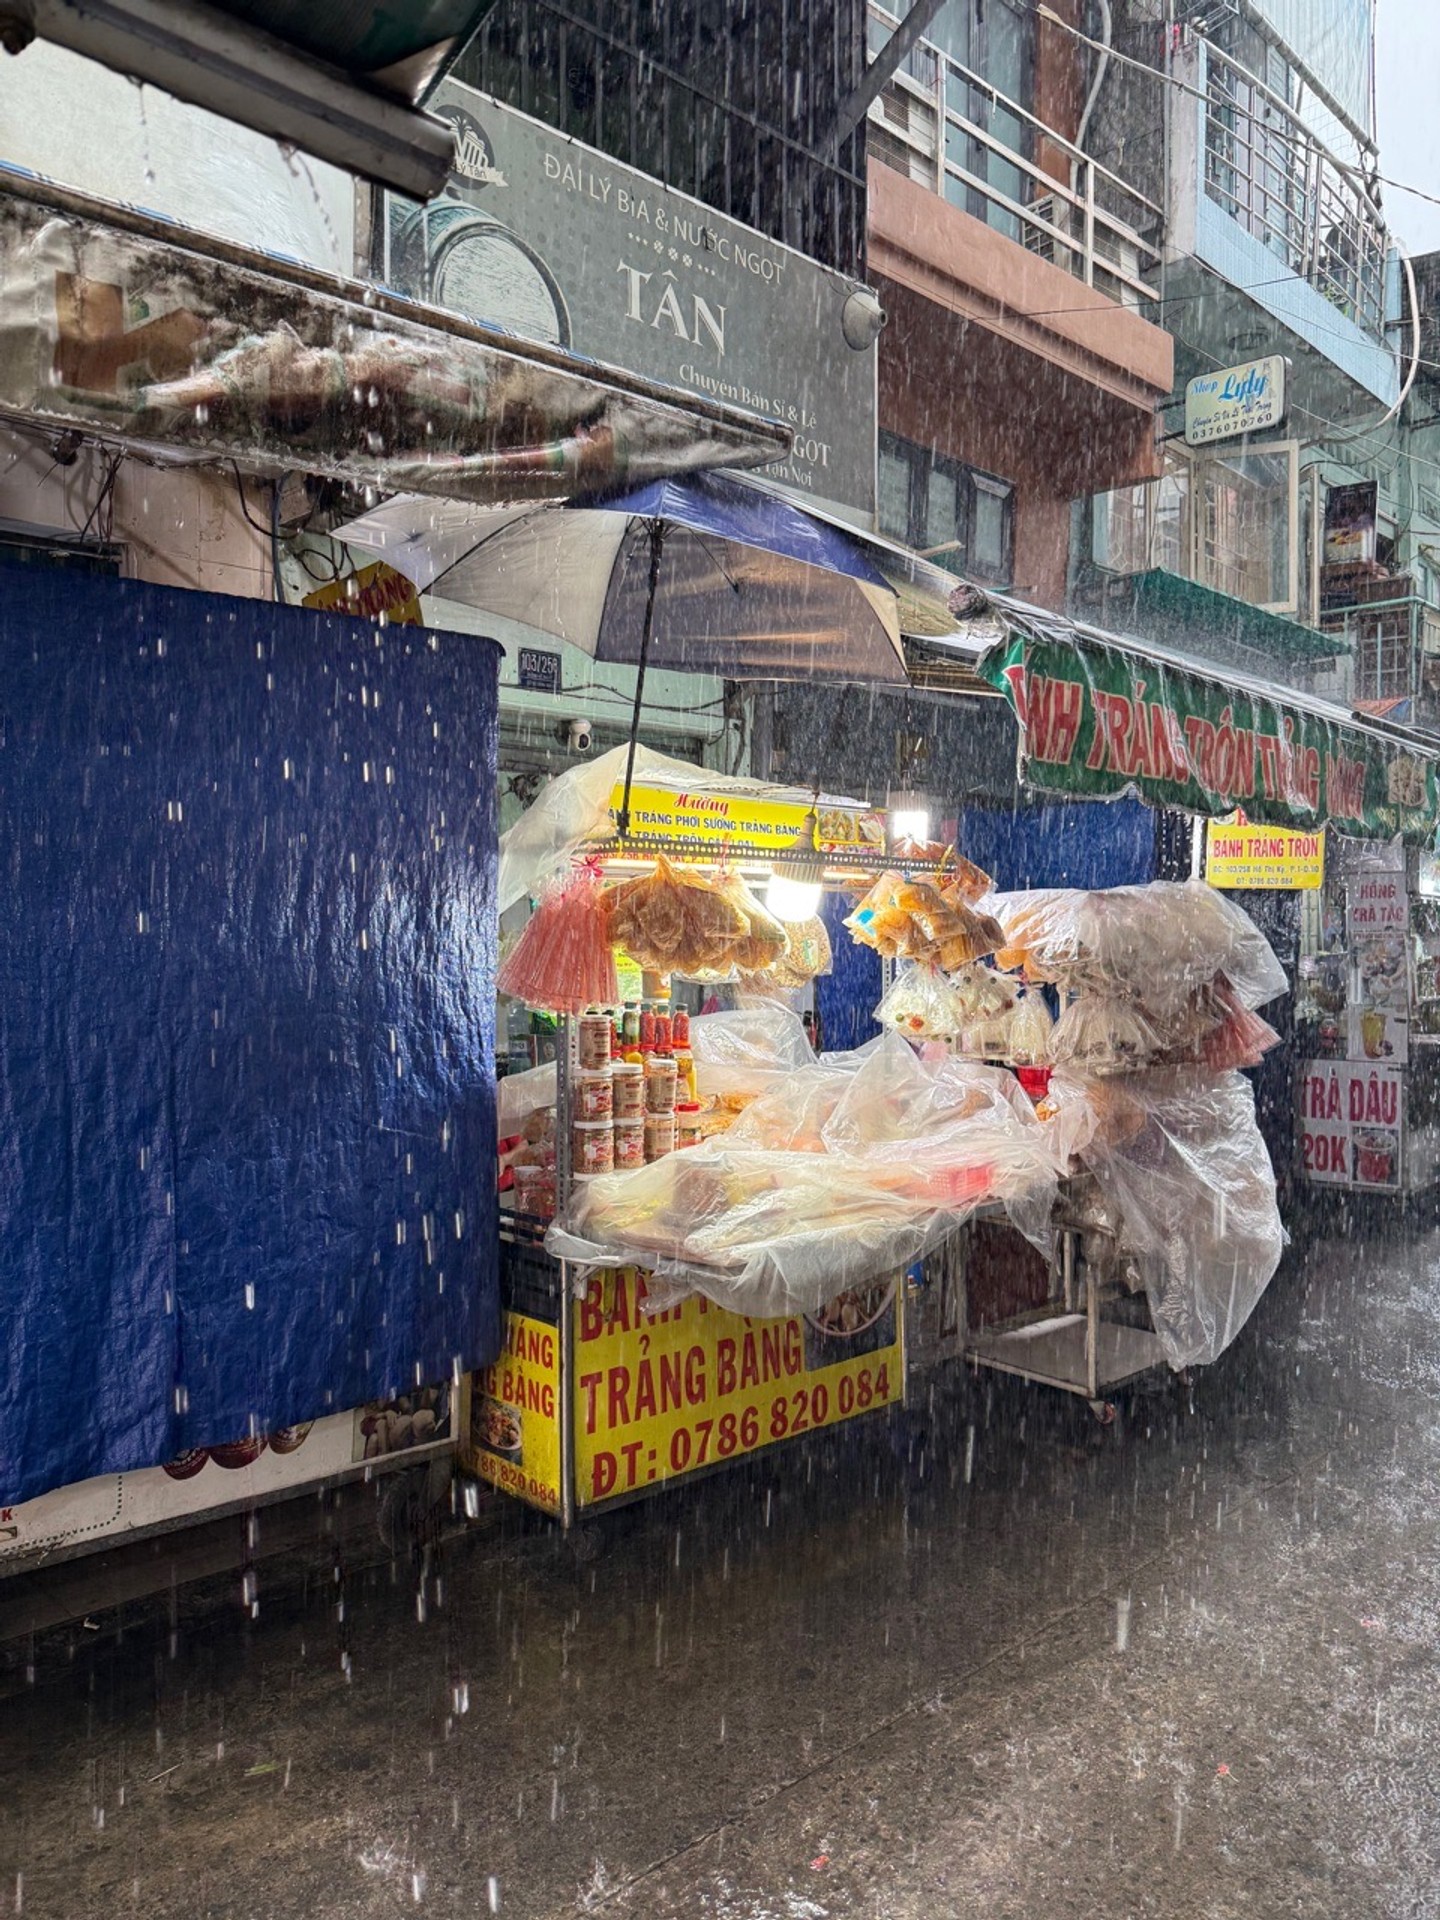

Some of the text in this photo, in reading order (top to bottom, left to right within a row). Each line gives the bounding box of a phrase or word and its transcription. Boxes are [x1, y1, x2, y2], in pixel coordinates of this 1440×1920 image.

[544, 153, 582, 193] ĐẠI
[590, 176, 612, 205] LÝ
[655, 208, 669, 234] &
[734, 244, 787, 286] NGỌT
[616, 257, 728, 357] TÂN
[679, 363, 738, 400] Chuyên
[741, 386, 770, 412] Bán
[787, 405, 799, 423] &
[793, 434, 832, 468] GỌT
[1192, 412, 1273, 440] 0376070760
[634, 810, 672, 825] TRÁNG
[1213, 834, 1243, 858] BÁNH
[1247, 833, 1284, 858] TRÁNG
[1301, 1067, 1398, 1125] TRÀ DÂU
[1302, 1133, 1347, 1174] 20K
[502, 1365, 555, 1420] BÀNG
[580, 1317, 801, 1436] TRẢNG BÀNG
[591, 1362, 891, 1499] ĐT: 0786 820 084
[501, 1462, 527, 1492] 820
[530, 1478, 557, 1506] 084
